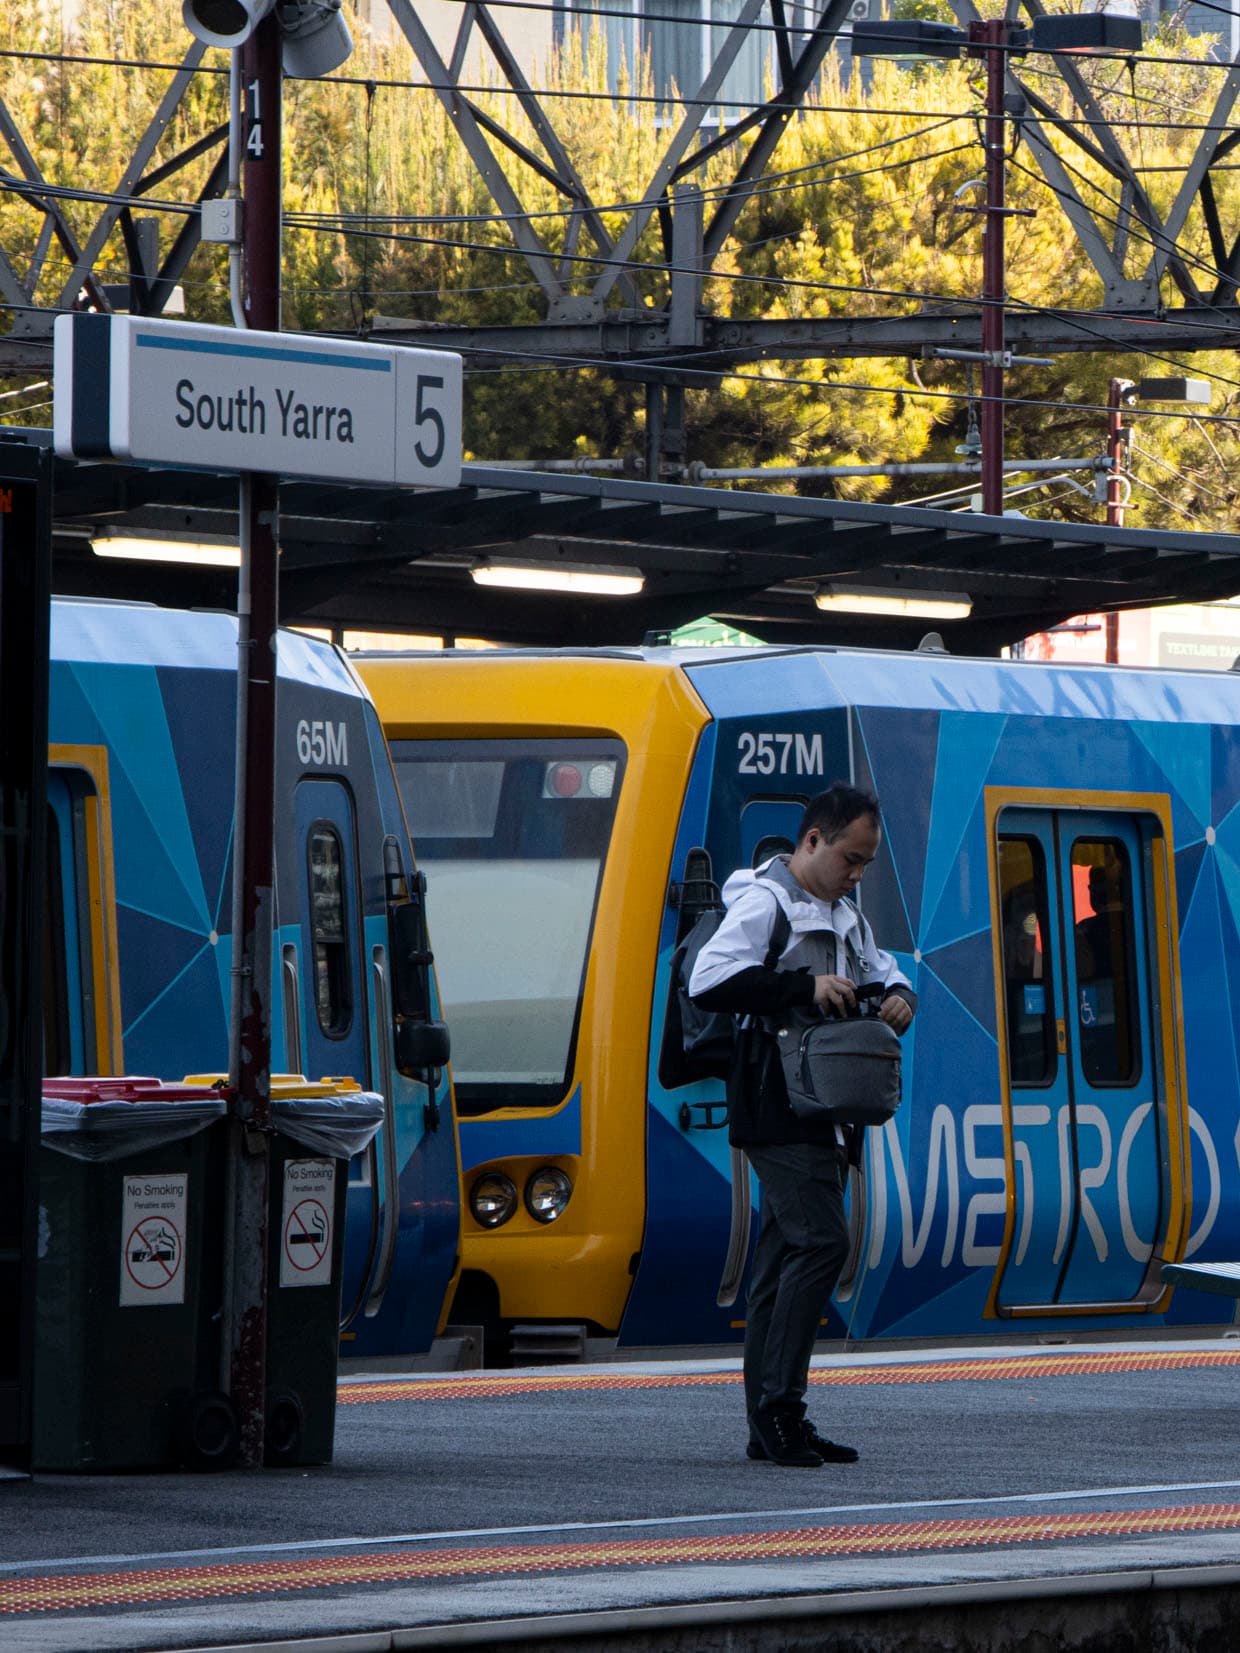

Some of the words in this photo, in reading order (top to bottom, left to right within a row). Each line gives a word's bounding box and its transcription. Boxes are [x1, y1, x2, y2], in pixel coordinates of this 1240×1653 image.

[175, 378, 266, 435] South
[275, 388, 354, 443] Yarra
[414, 374, 445, 468] 5
[296, 719, 348, 767] 65M
[737, 732, 824, 776] 257M
[127, 1185, 141, 1197] No
[143, 1183, 184, 1198] Smoking
[287, 1168, 299, 1180] No
[300, 1167, 333, 1181] Smoking
[866, 1102, 1221, 1270] METRO
